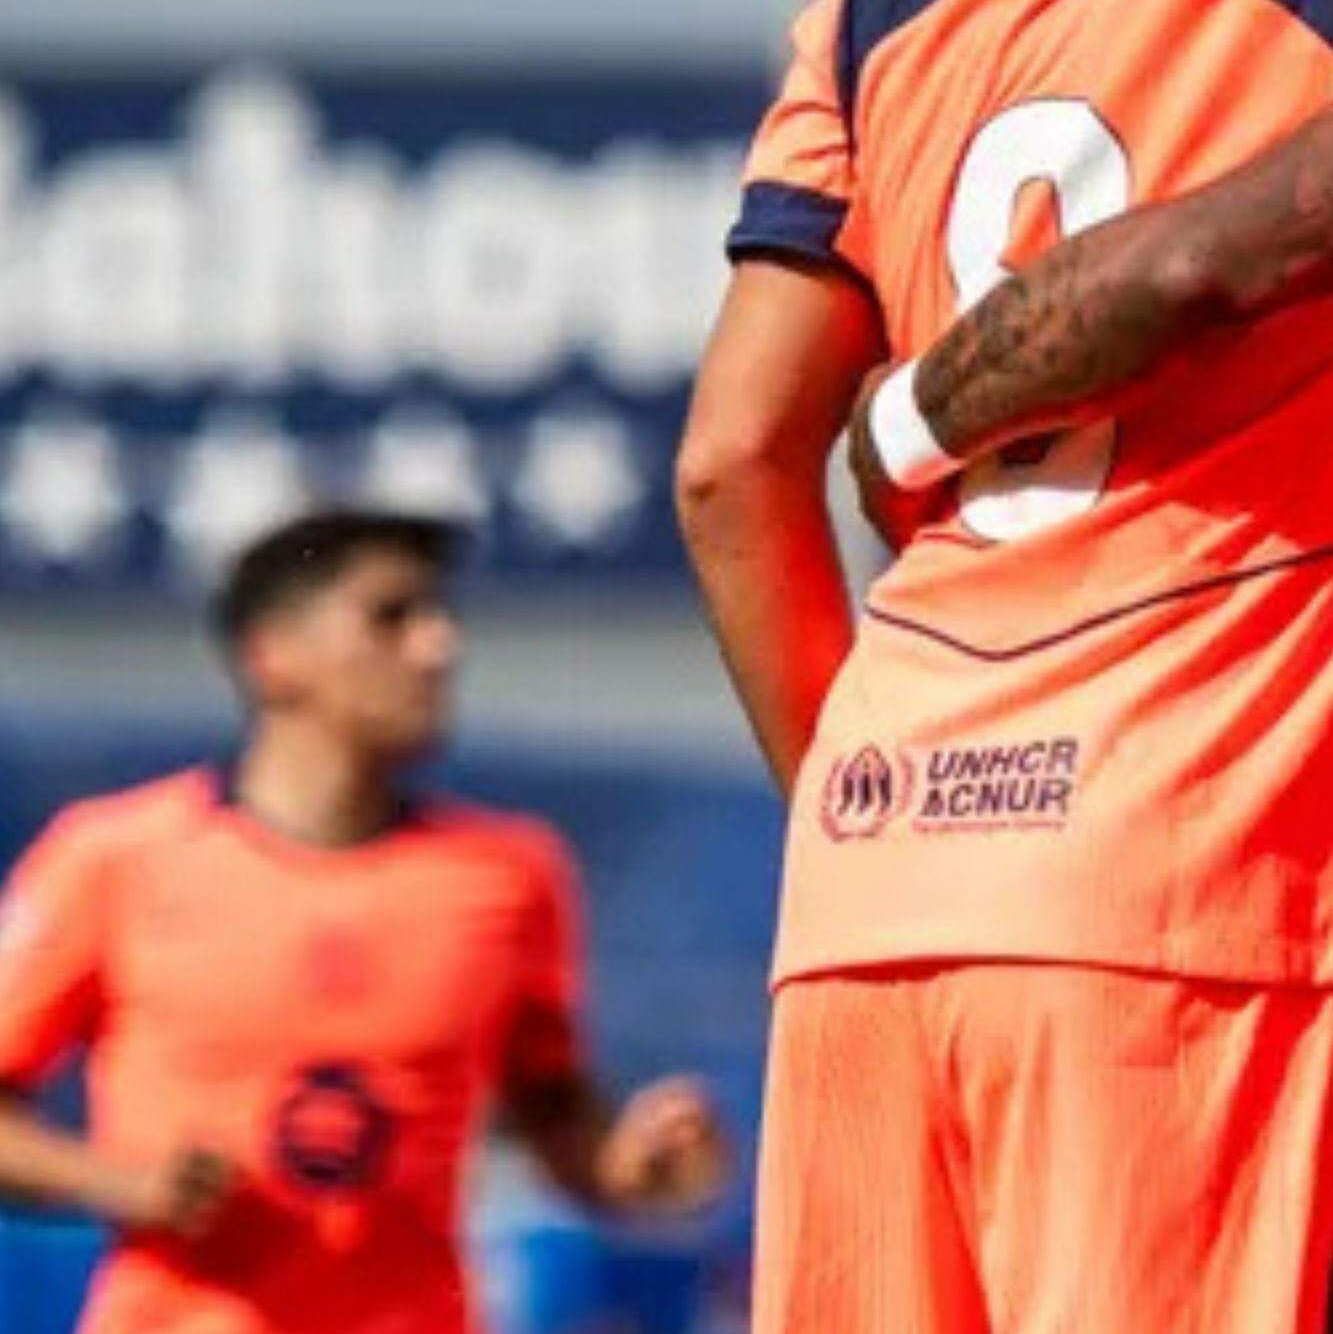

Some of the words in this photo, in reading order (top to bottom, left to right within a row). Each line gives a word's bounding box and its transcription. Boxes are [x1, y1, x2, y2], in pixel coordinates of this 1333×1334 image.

[0, 59, 738, 395] ahou
[925, 738, 1079, 783] UNHCR
[921, 778, 1074, 817] ACNUR
